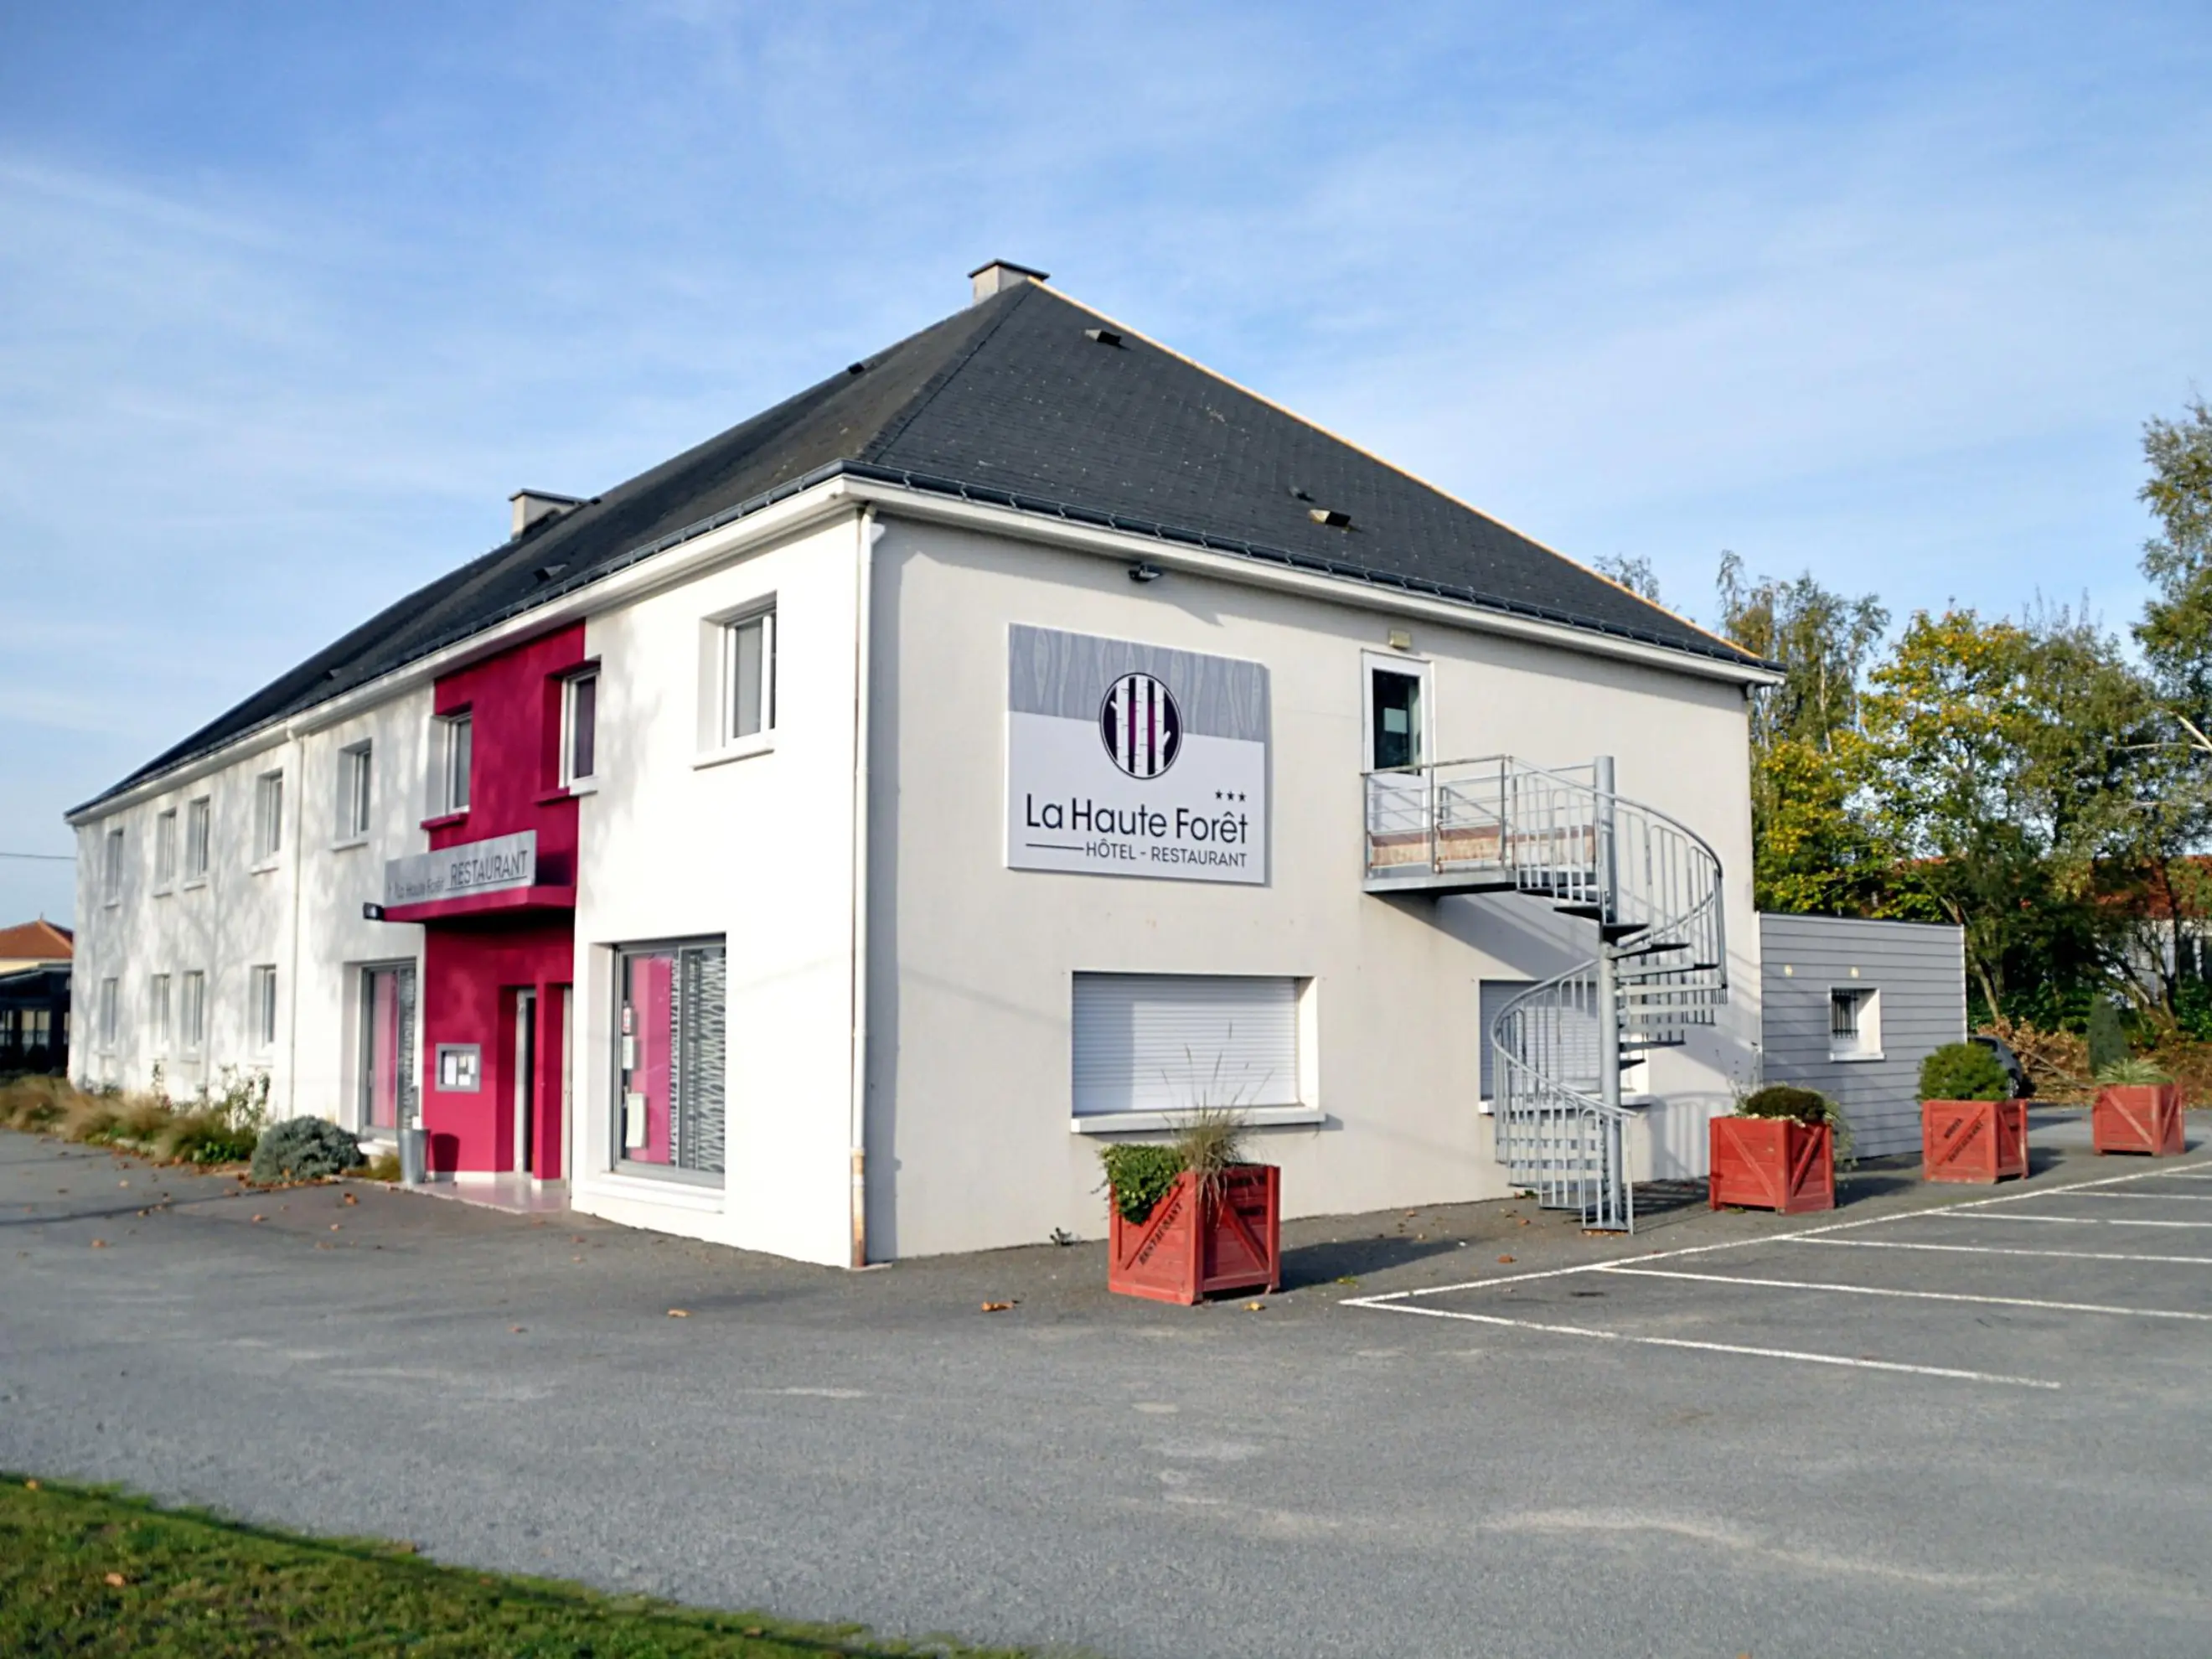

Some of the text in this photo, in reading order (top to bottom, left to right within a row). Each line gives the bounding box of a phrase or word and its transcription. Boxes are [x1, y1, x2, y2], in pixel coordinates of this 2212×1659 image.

[1026, 793, 1248, 844] La Haute Forêt
[450, 850, 528, 886] RESTAURANT
[1086, 838, 1136, 861] HÔTEL
[1151, 846, 1248, 867] RESTAURANT
